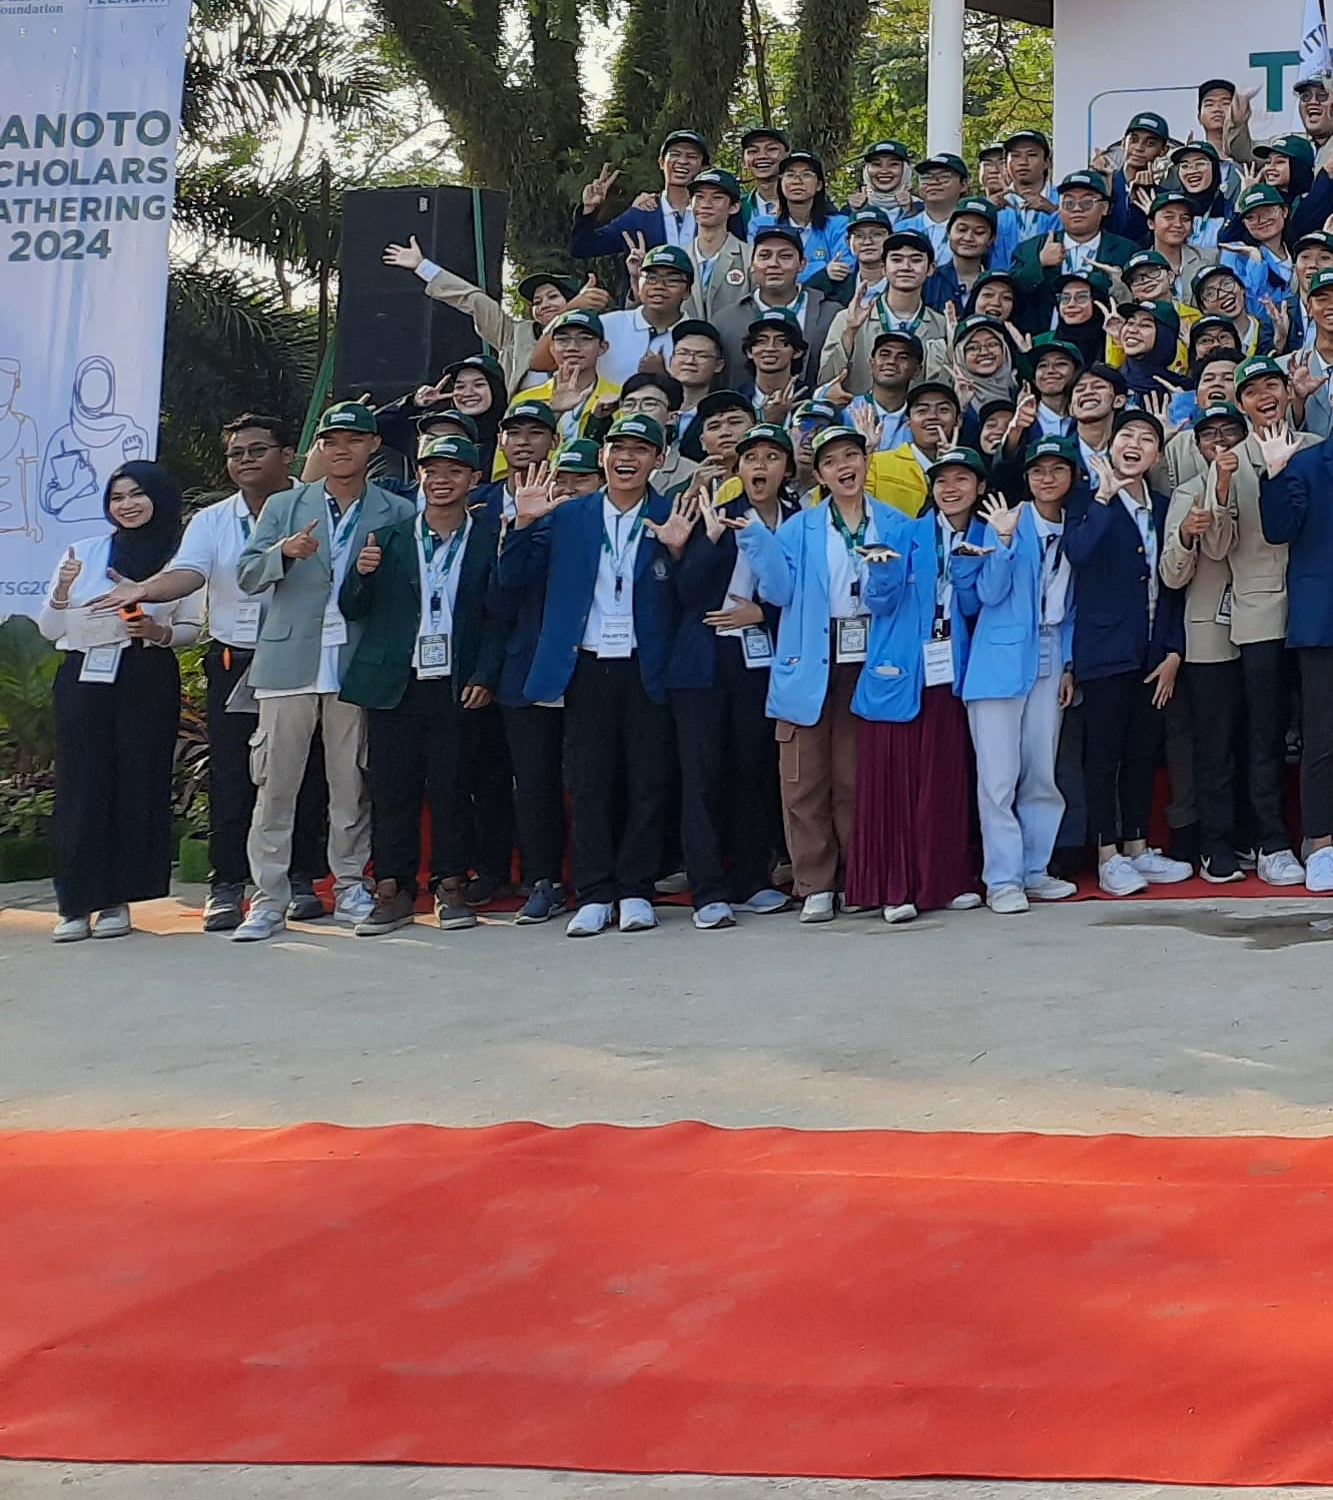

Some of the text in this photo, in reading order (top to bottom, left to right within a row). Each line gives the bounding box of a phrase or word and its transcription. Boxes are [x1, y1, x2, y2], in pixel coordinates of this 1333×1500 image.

[0, 3, 64, 15] oundation
[0, 110, 172, 150] ANOTO
[0, 156, 168, 188] CHOLARS
[0, 195, 167, 224] ATHERING
[8, 228, 112, 263] 2024
